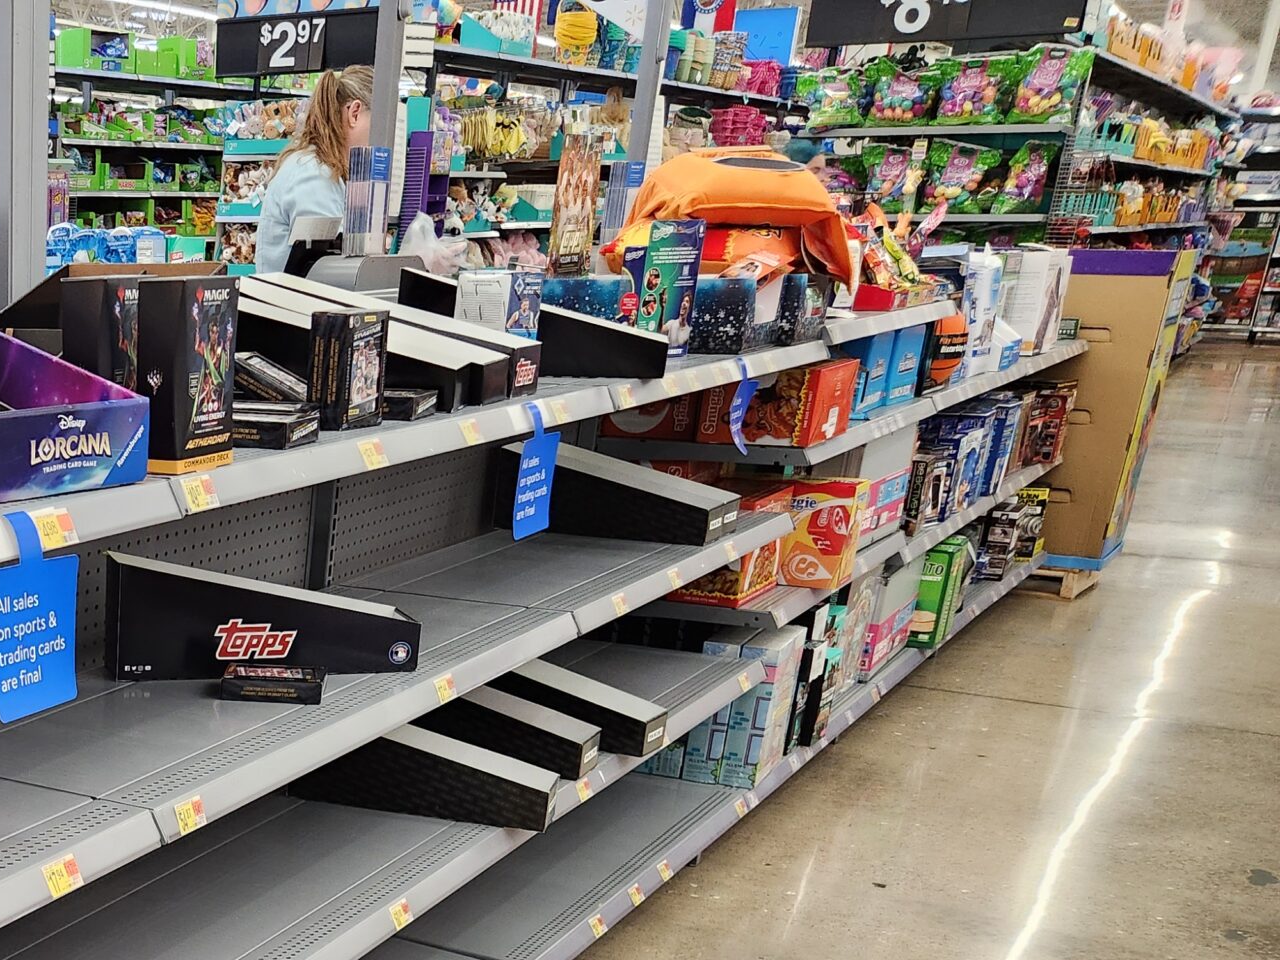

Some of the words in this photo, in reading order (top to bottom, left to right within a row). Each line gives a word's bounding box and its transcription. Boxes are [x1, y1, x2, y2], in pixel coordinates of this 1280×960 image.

[203, 288, 231, 301] MAGIC
[57, 414, 87, 432] Disney
[193, 412, 209, 424] LIVING
[208, 410, 226, 422] ENERGY
[29, 431, 113, 467] LORCANA
[116, 424, 145, 468] Ravensburger
[42, 463, 67, 474] TRADING
[67, 461, 82, 469] CARD
[82, 460, 98, 468] GAME
[183, 455, 216, 469] COMMANDER
[216, 453, 230, 464] DECK
[521, 458, 529, 470] All
[528, 456, 540, 468] sales
[526, 471, 541, 486] sports
[540, 468, 546, 480] &
[517, 489, 535, 504] trading
[534, 484, 548, 498] cards
[515, 510, 525, 521] are
[524, 503, 536, 518] final
[790, 496, 817, 512] ggie
[13, 591, 39, 612] sales
[13, 617, 46, 641] sports
[48, 611, 57, 628] &
[38, 634, 66, 656] cards
[1, 677, 19, 693] are
[19, 664, 42, 687] final
